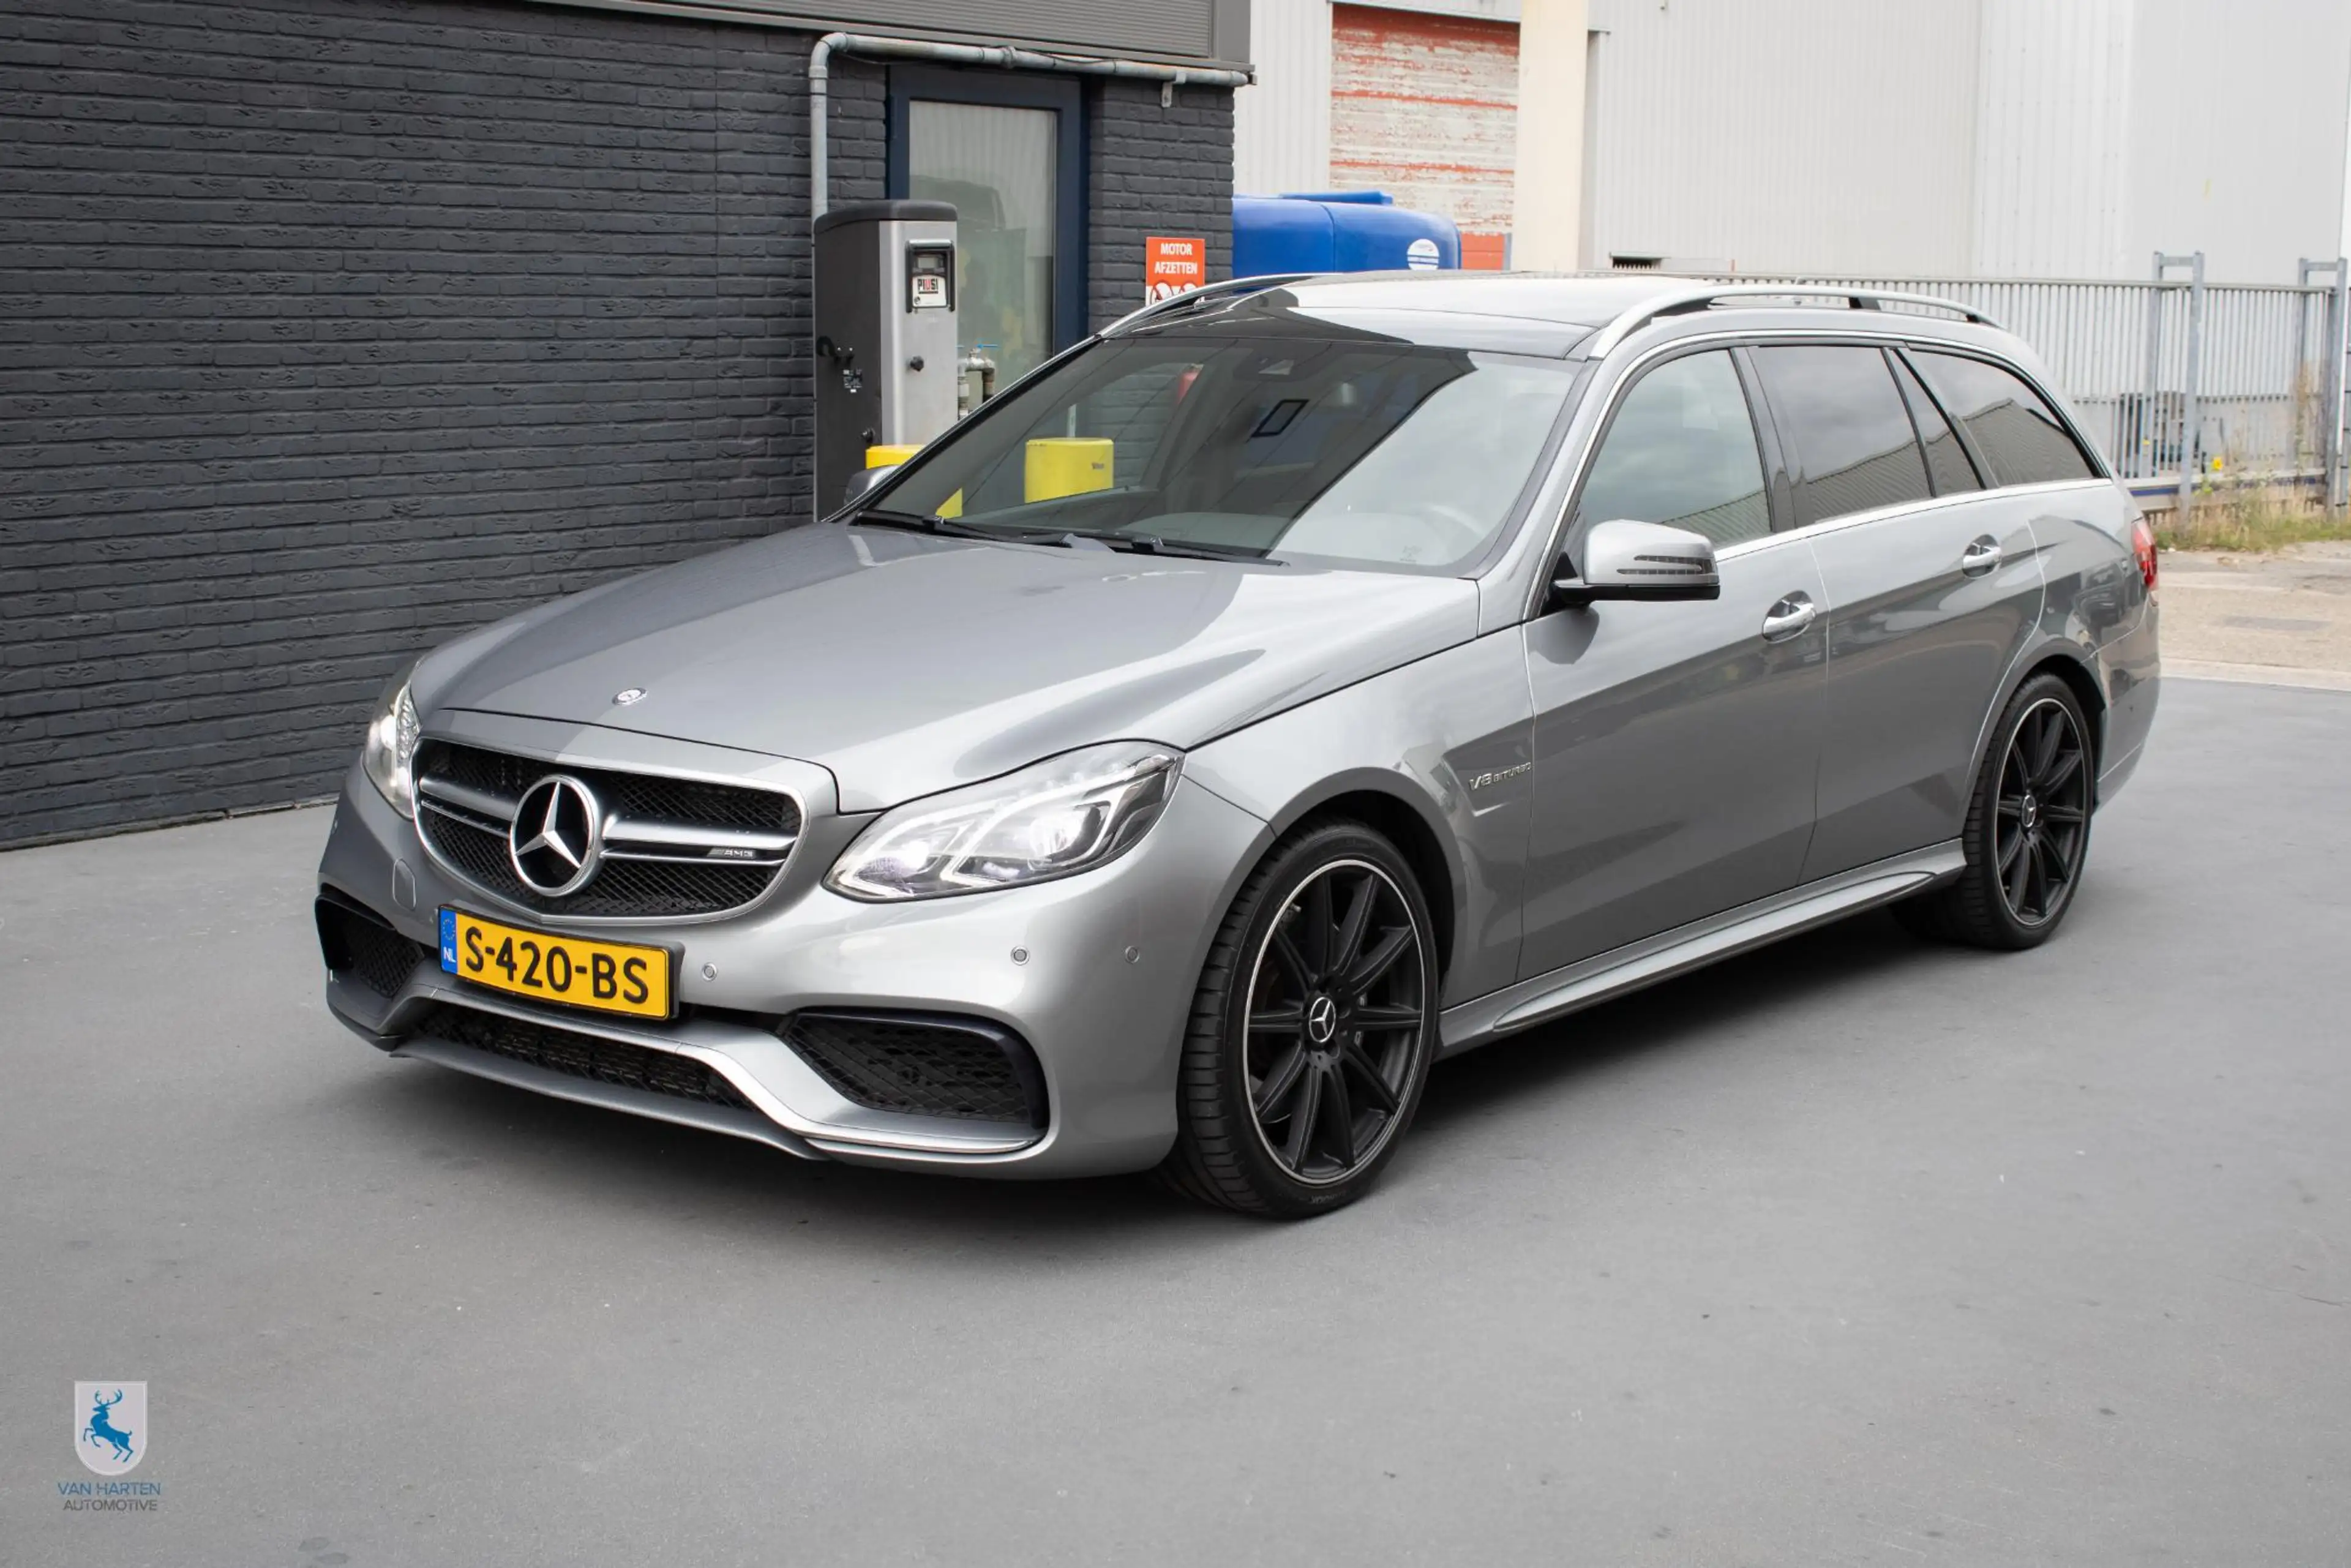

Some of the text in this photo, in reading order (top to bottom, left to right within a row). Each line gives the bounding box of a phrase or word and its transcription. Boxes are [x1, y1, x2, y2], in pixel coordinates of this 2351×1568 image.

[1160, 242, 1193, 255] MOTOR
[1155, 261, 1198, 275] AFZETTEN
[917, 278, 939, 290] PIUSI
[1469, 773, 1492, 790] V8
[443, 946, 456, 963] NL
[465, 925, 649, 1005] S-420-BS
